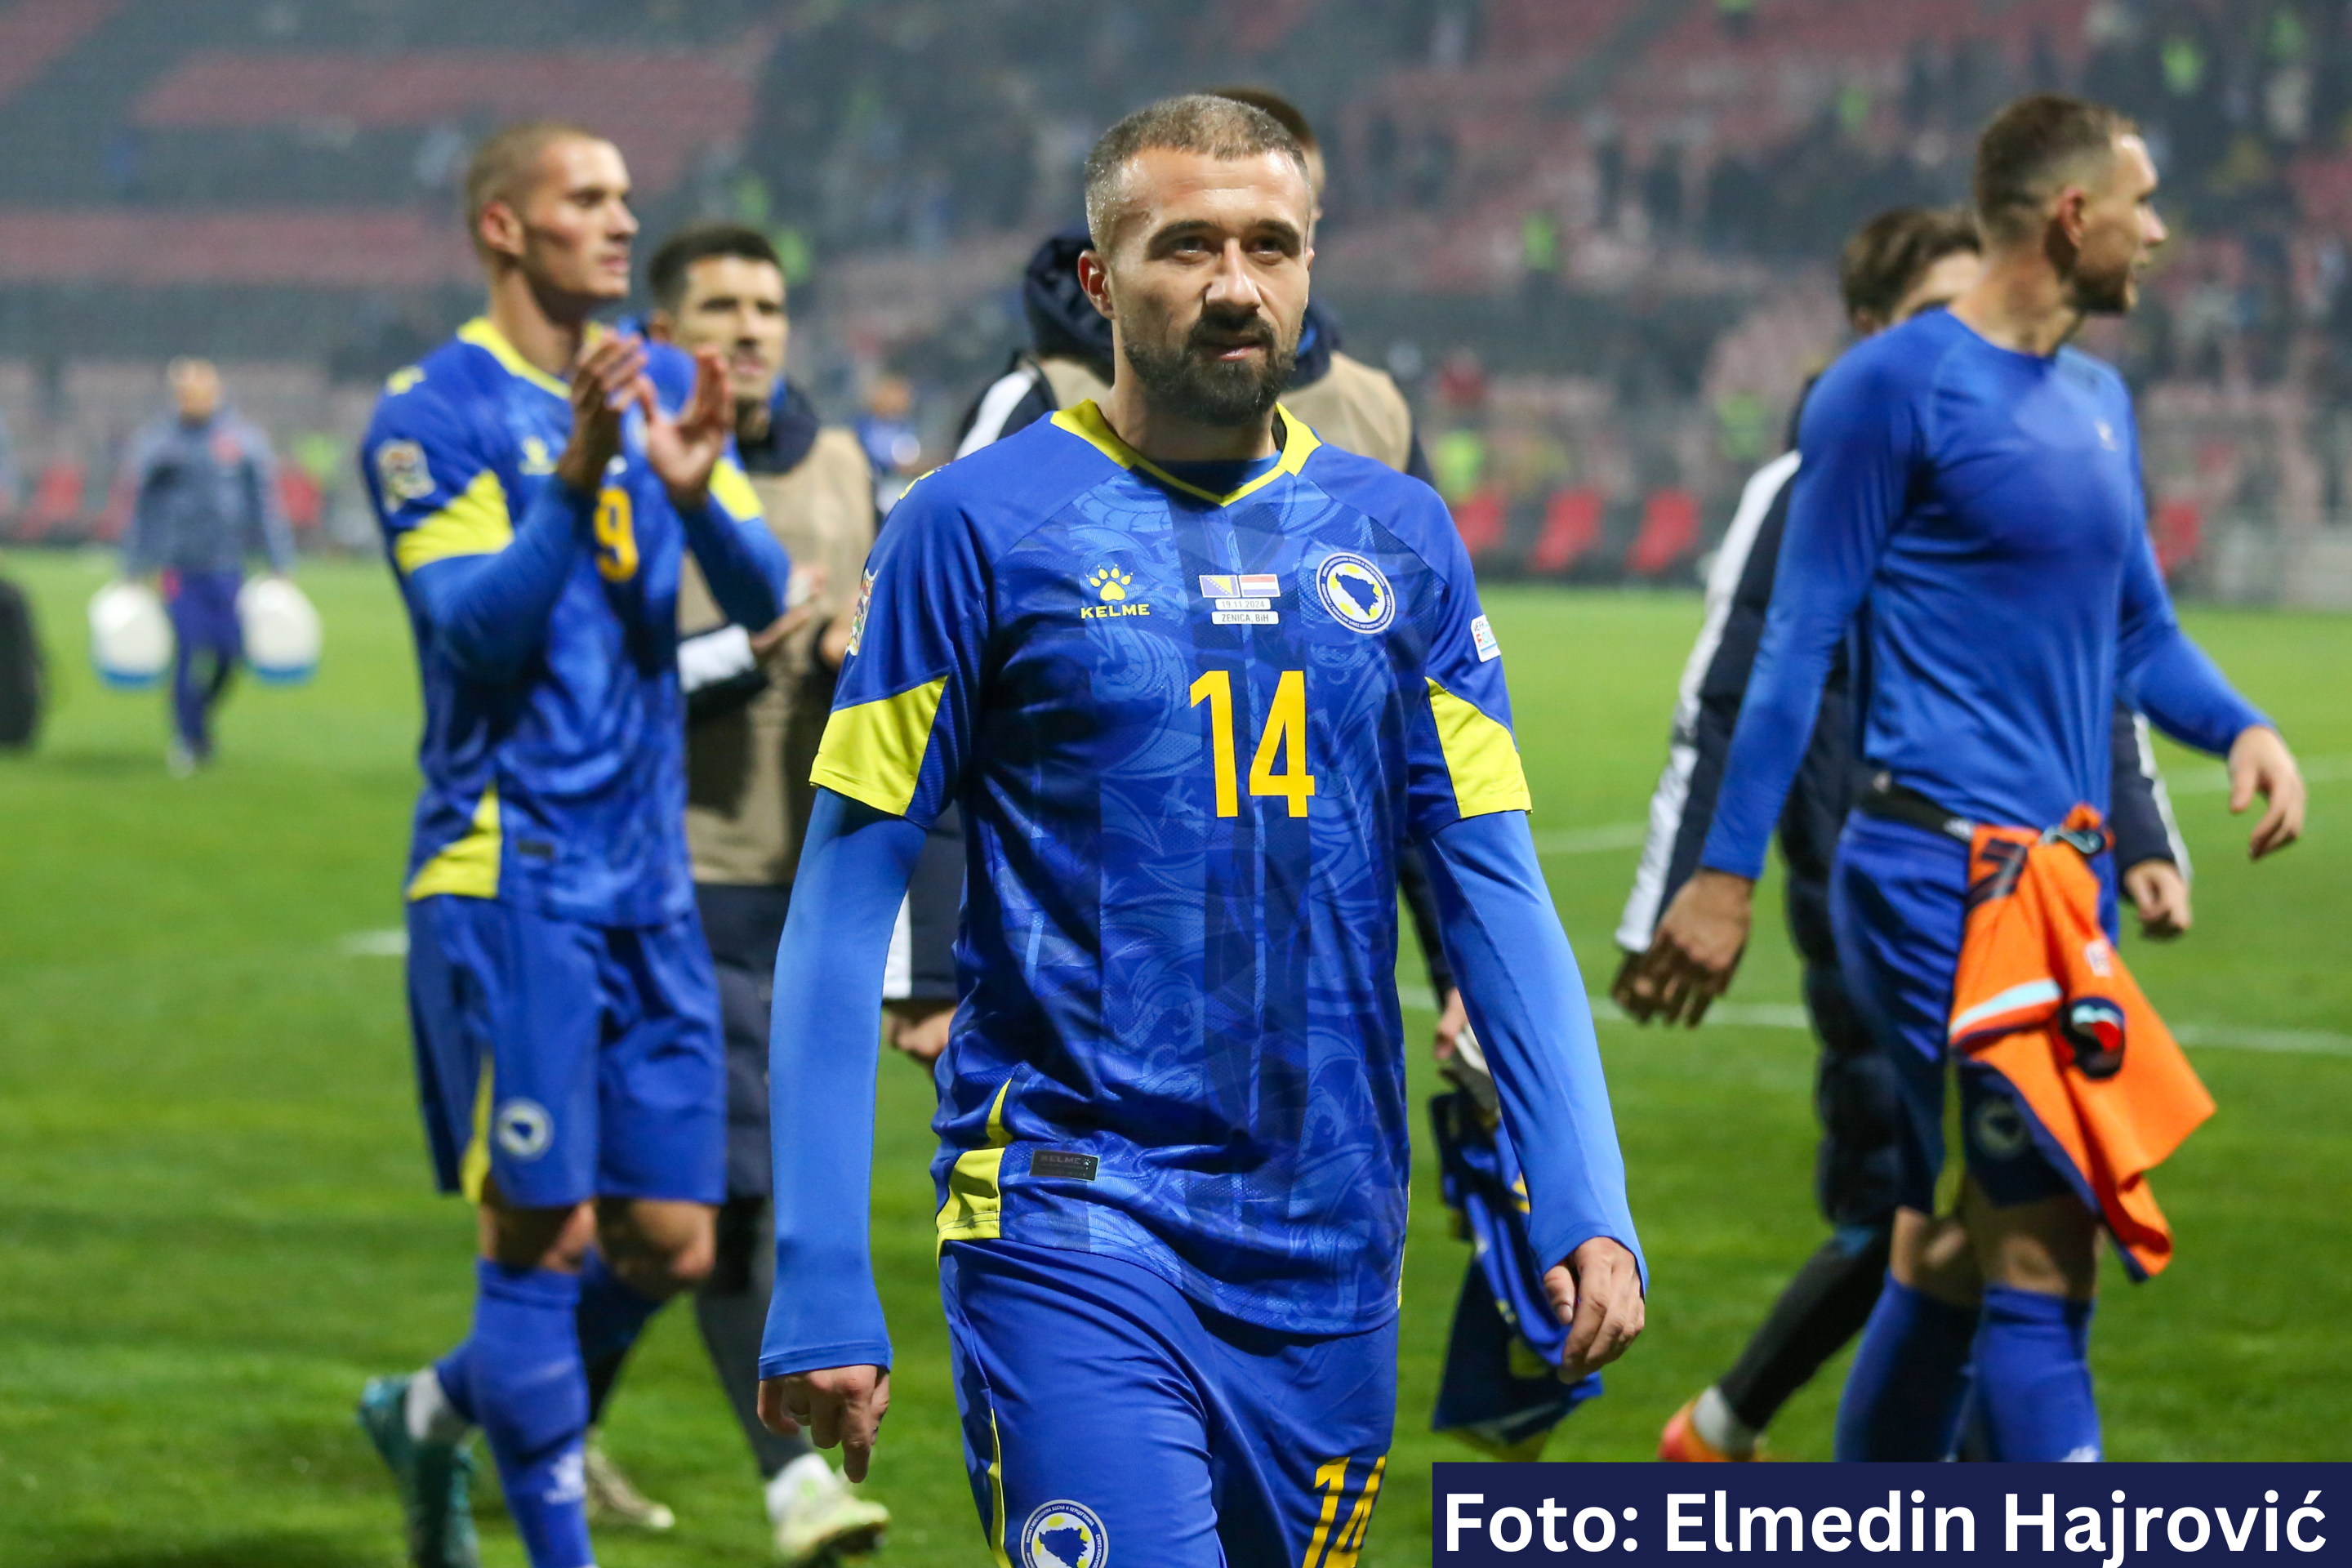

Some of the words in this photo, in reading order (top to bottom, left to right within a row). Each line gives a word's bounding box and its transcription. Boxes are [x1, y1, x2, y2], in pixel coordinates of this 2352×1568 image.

[595, 488, 639, 580] 9
[1080, 604, 1151, 619] KELME
[1222, 600, 1265, 608] 19.11.2024
[1222, 613, 1253, 623] ZENICA,
[1255, 613, 1269, 622] BiH
[1189, 670, 1316, 817] 14
[1040, 1154, 1082, 1165] KELME
[1303, 1455, 1387, 1568] 14
